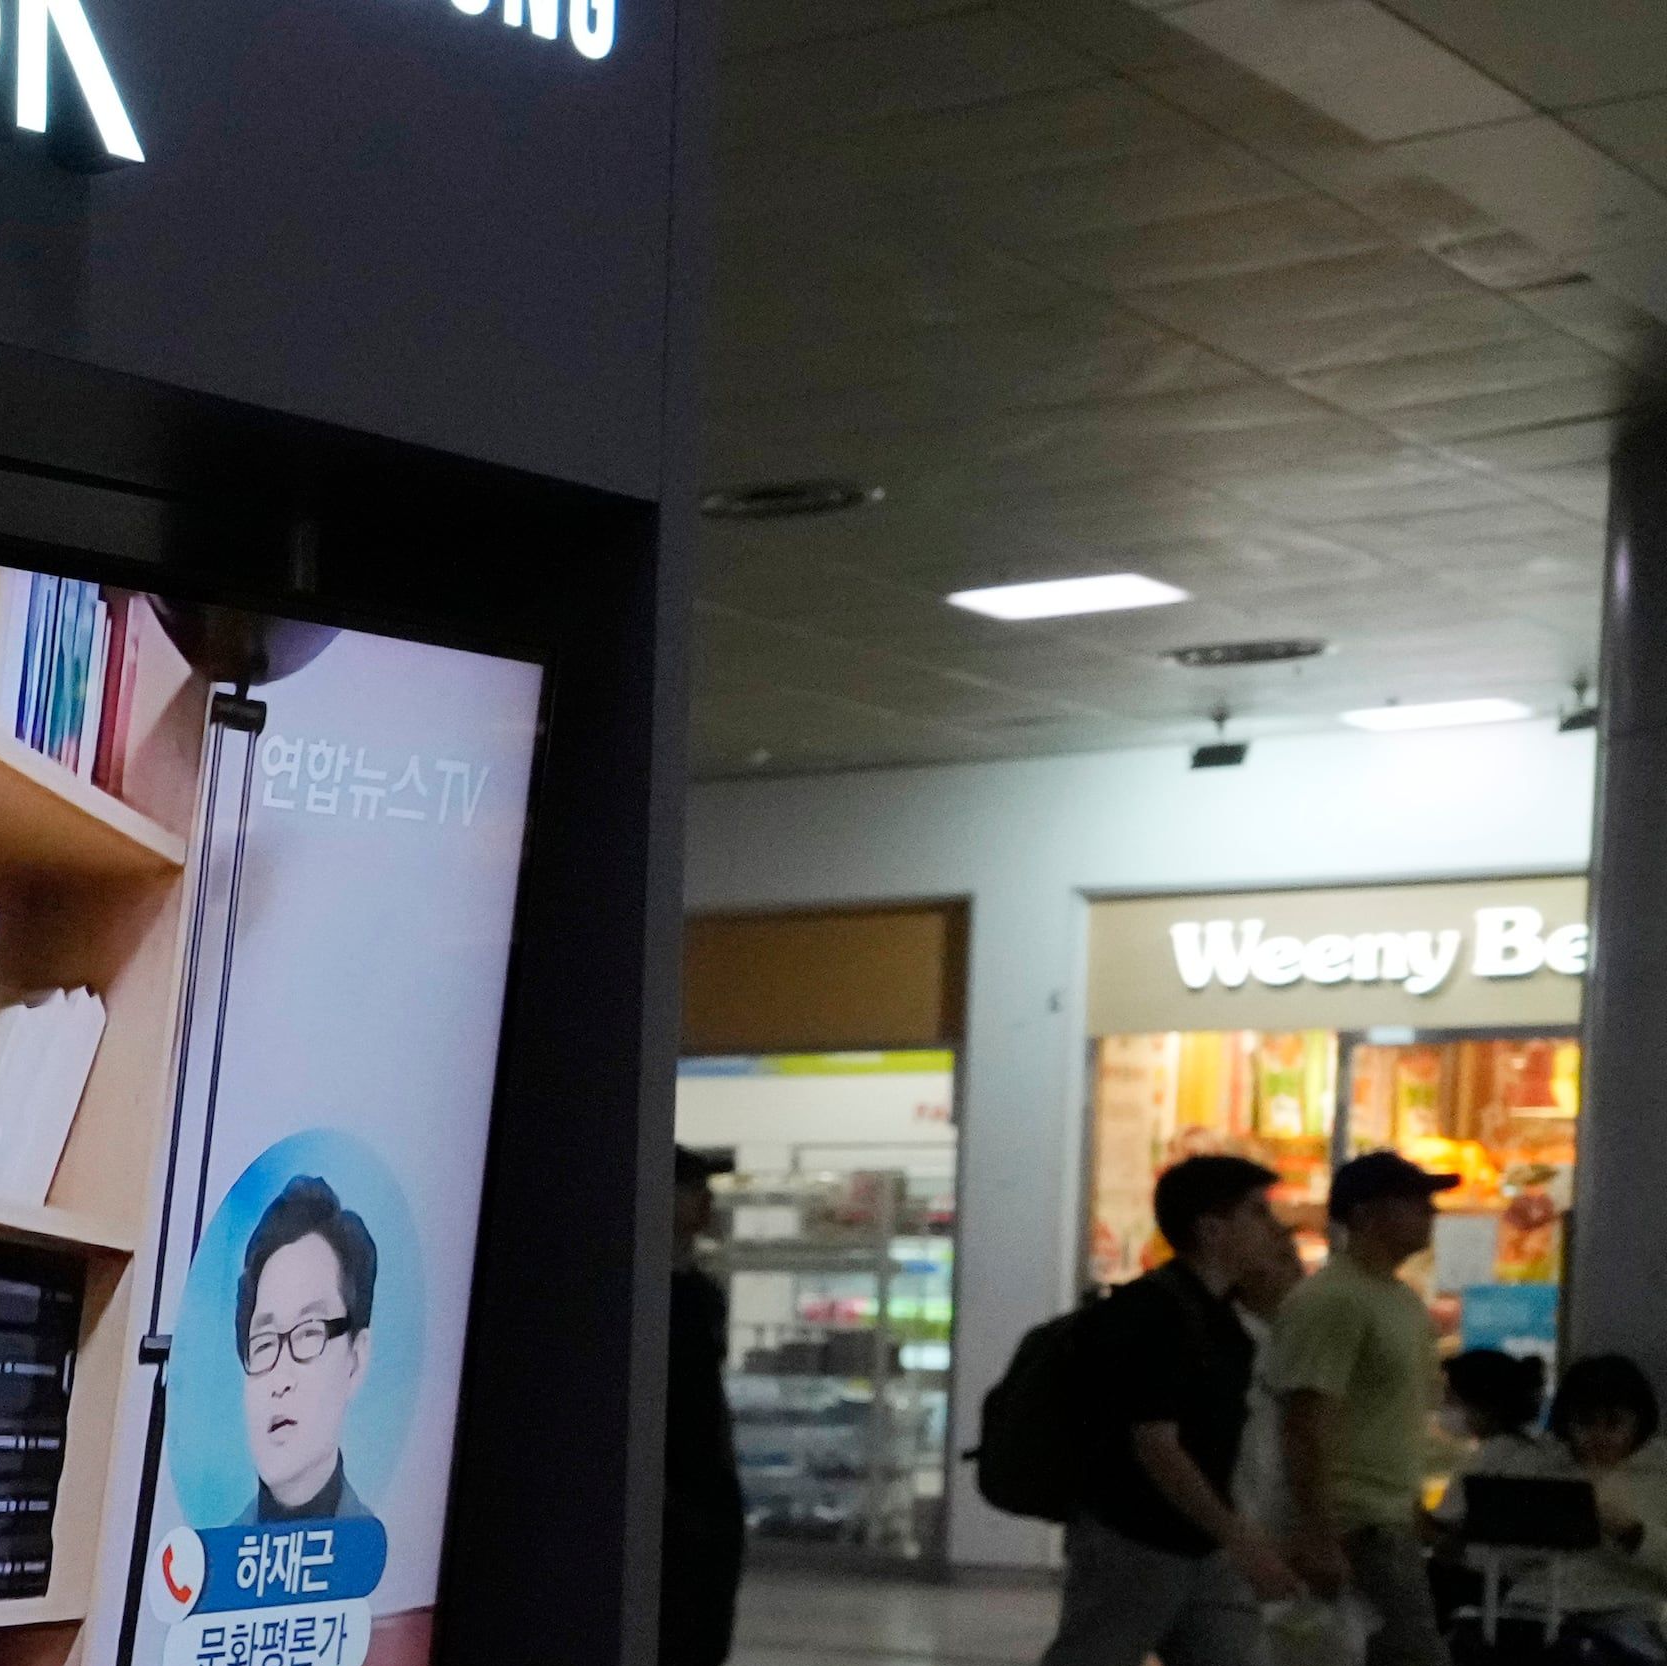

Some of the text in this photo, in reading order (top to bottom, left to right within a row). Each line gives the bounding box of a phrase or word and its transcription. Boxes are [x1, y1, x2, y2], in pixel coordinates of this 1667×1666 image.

[260, 733, 491, 827] 연합뉴스TV
[1170, 918, 1462, 996] Weeny
[236, 1529, 335, 1598] 하재근
